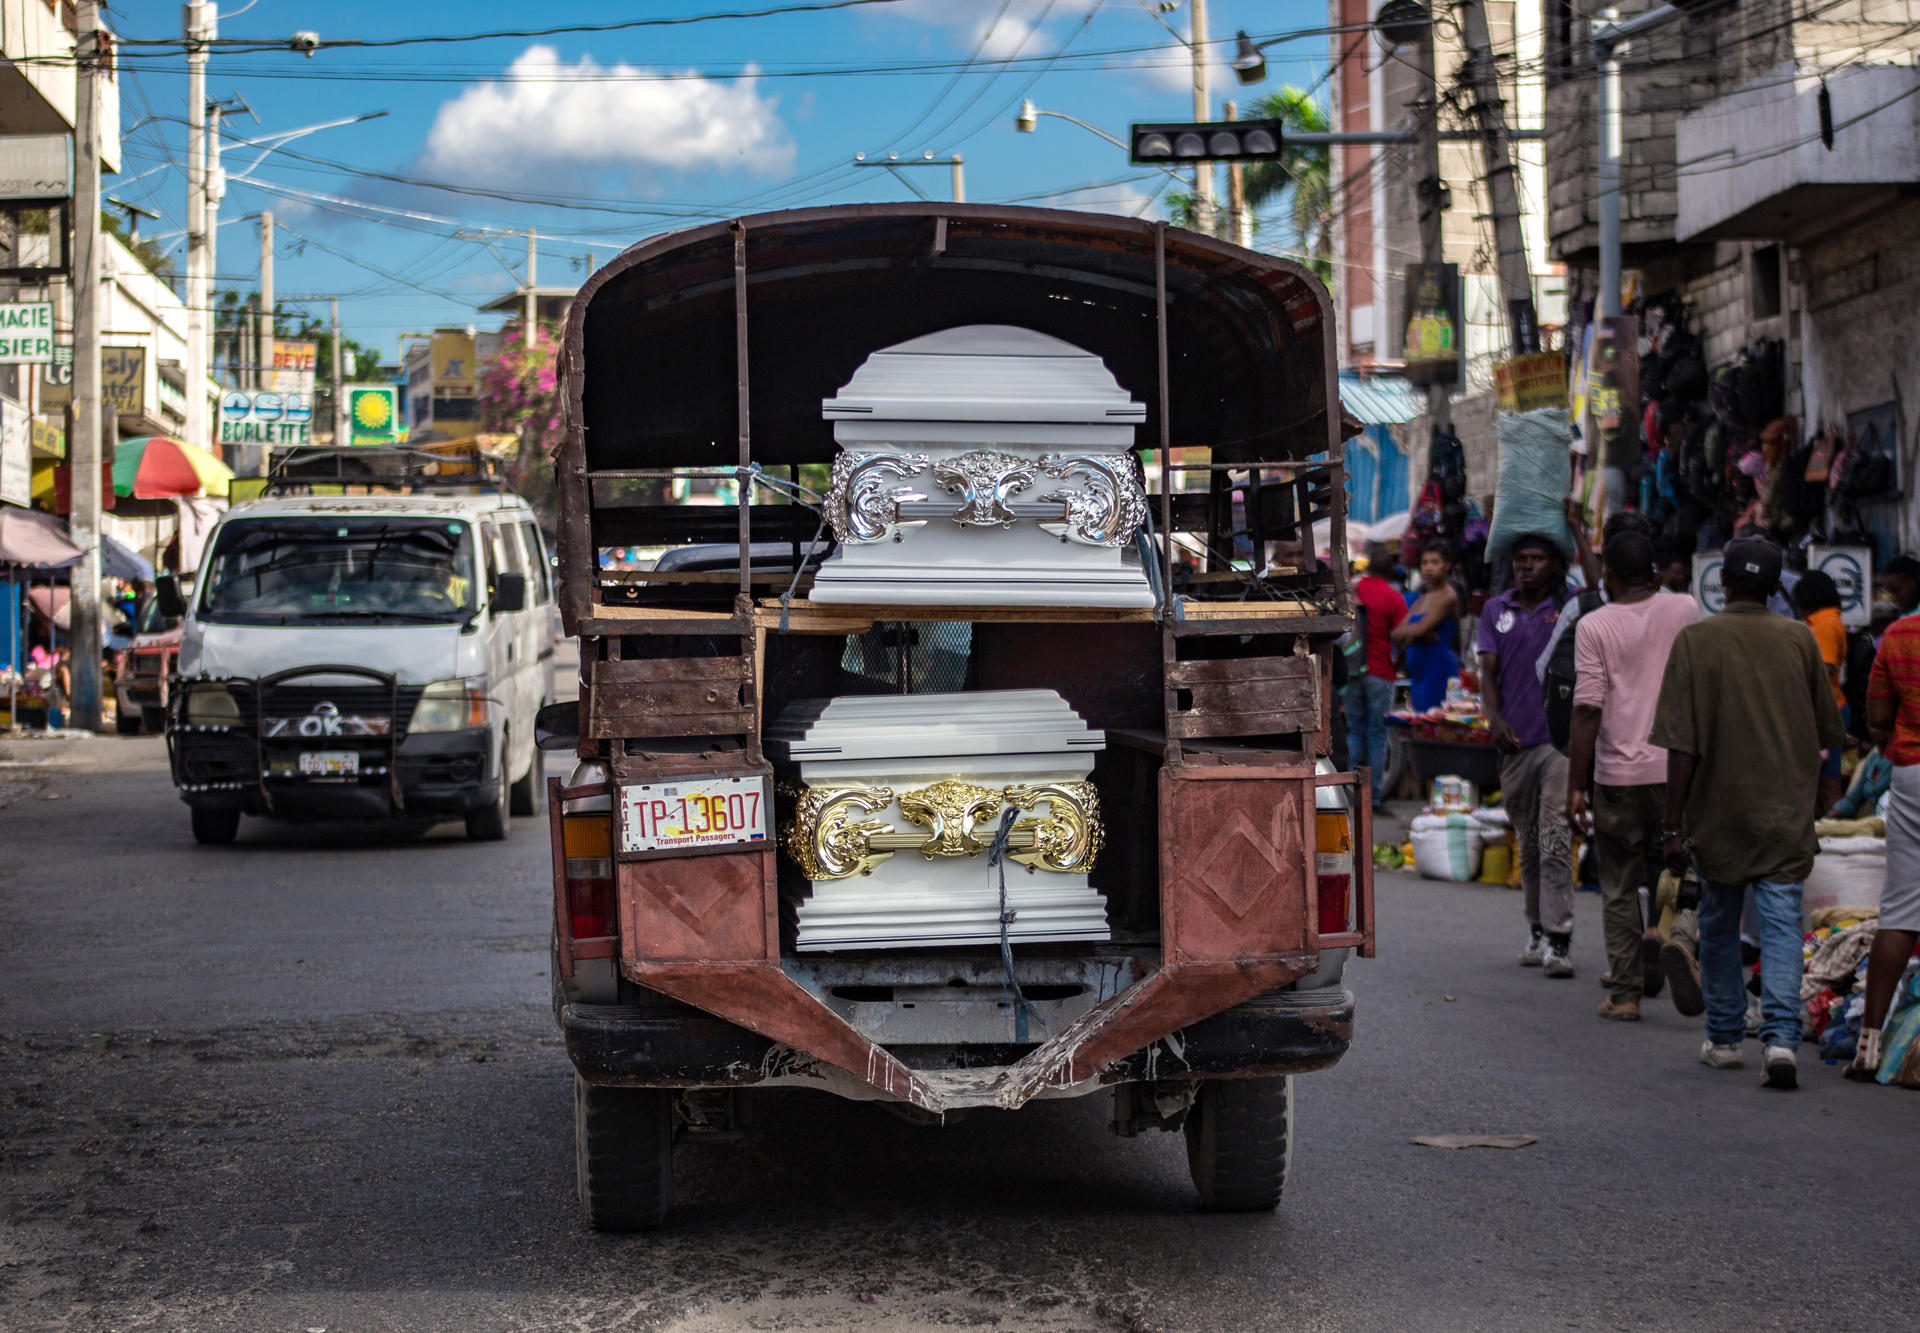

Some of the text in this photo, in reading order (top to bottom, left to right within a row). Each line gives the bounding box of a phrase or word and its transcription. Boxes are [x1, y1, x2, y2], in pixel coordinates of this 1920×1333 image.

[101, 351, 141, 384] sly
[222, 421, 310, 443] BORLETTE
[300, 715, 342, 736] OK
[621, 790, 630, 842] HAITI
[656, 835, 694, 846] Transport
[695, 833, 736, 843] Passagers
